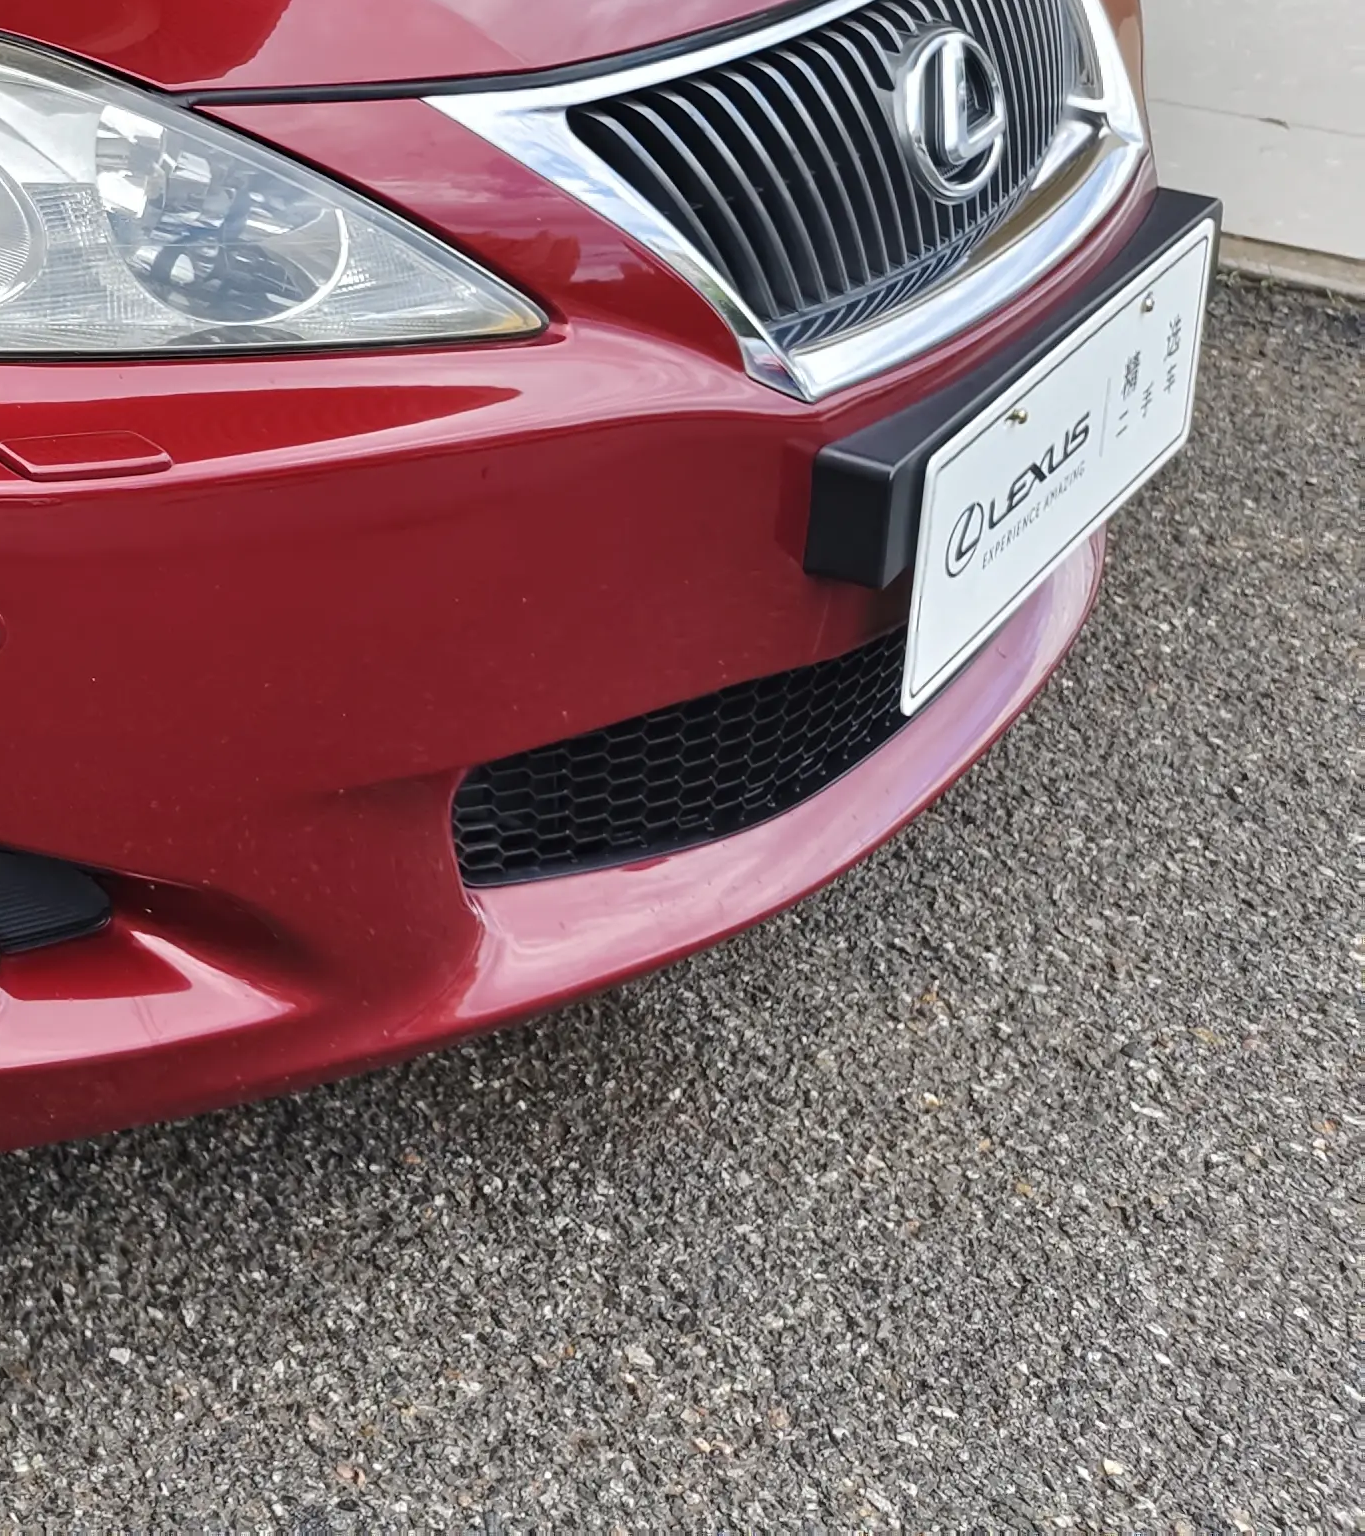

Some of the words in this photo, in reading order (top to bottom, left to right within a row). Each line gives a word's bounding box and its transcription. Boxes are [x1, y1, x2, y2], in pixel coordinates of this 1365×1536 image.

[981, 500, 1042, 571] EXPERIENCE
[1042, 459, 1086, 513] AMAZING
[988, 410, 1090, 530] LEXUS
